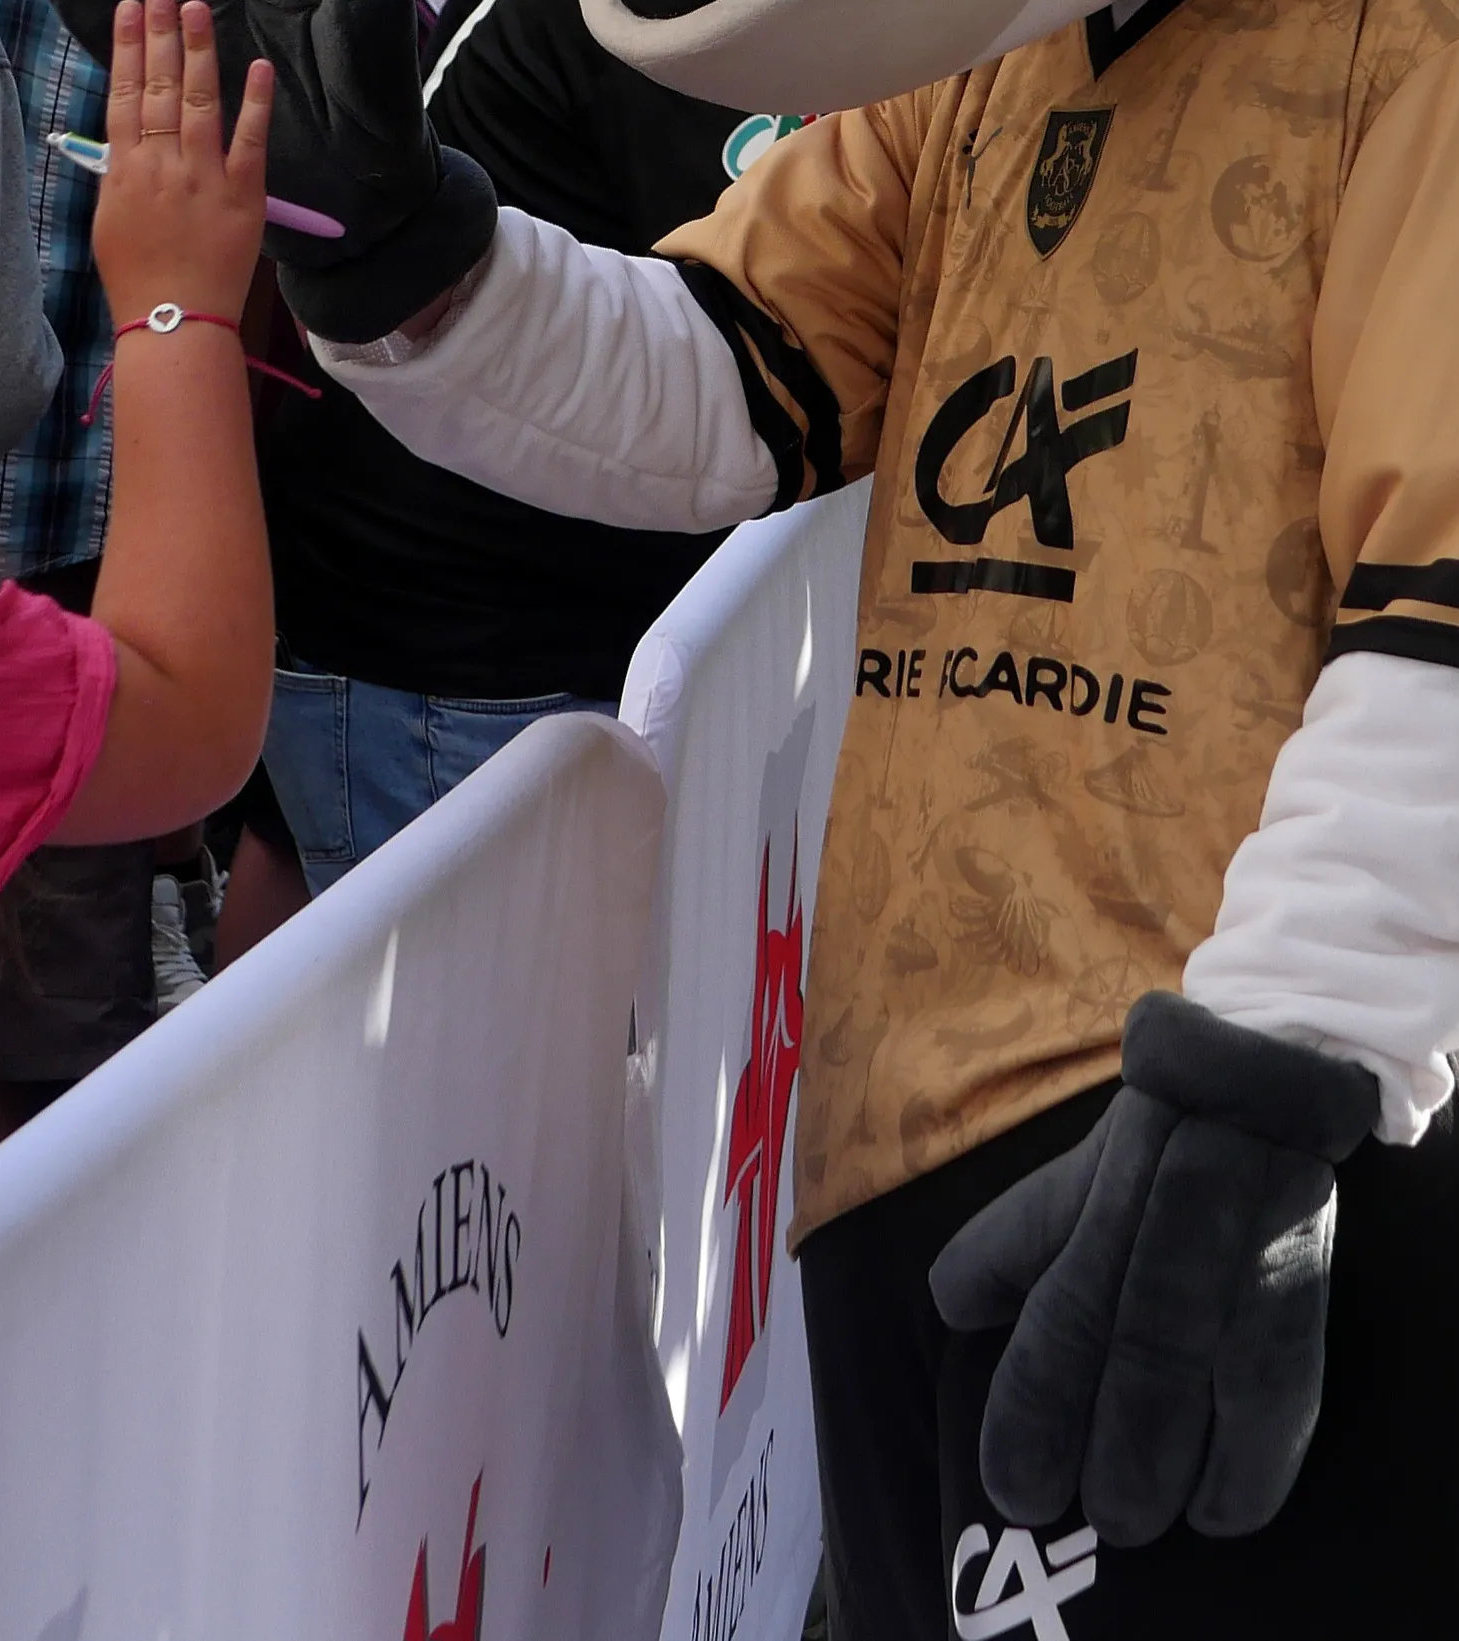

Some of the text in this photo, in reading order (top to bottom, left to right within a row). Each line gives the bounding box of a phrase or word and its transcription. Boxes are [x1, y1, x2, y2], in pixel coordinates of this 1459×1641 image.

[855, 646, 1173, 736] RIE CARDIE
[355, 1158, 522, 1535] AMIENS
